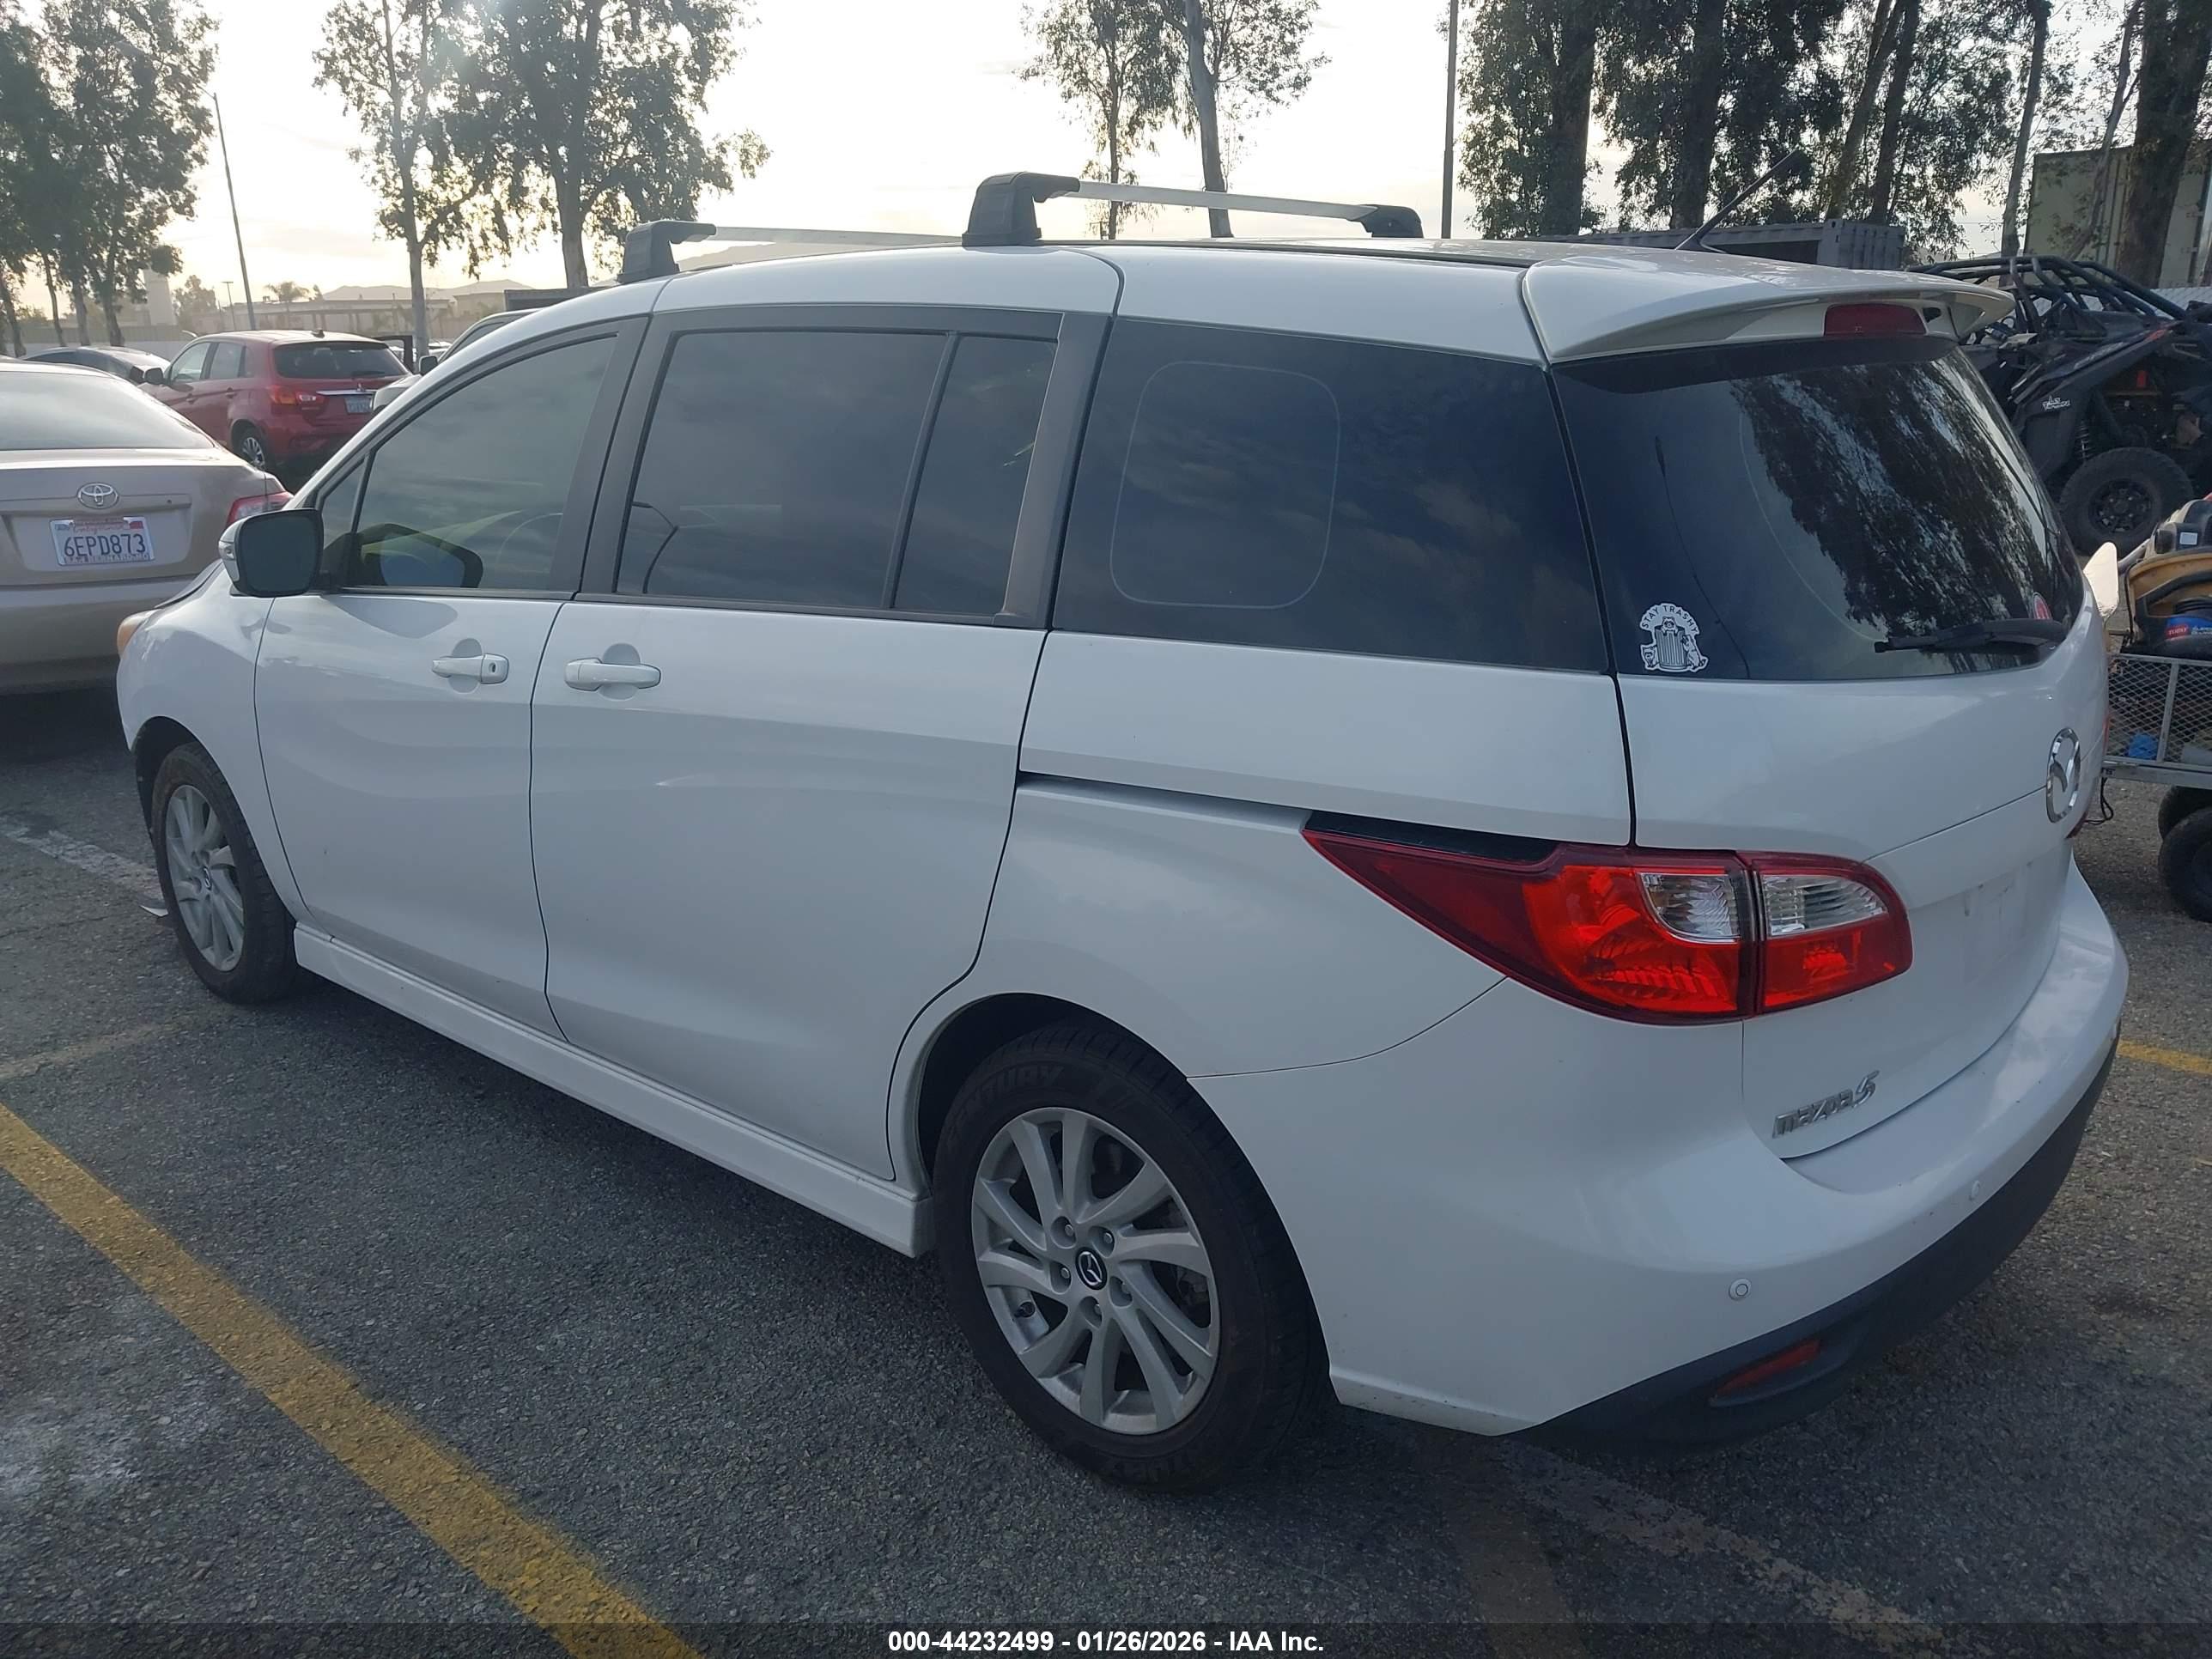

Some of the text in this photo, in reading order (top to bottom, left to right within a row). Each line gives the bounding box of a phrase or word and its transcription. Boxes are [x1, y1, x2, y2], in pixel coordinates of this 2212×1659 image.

[64, 534, 146, 557] 6EPD873
[1641, 605, 1698, 633] STAY TRASHY
